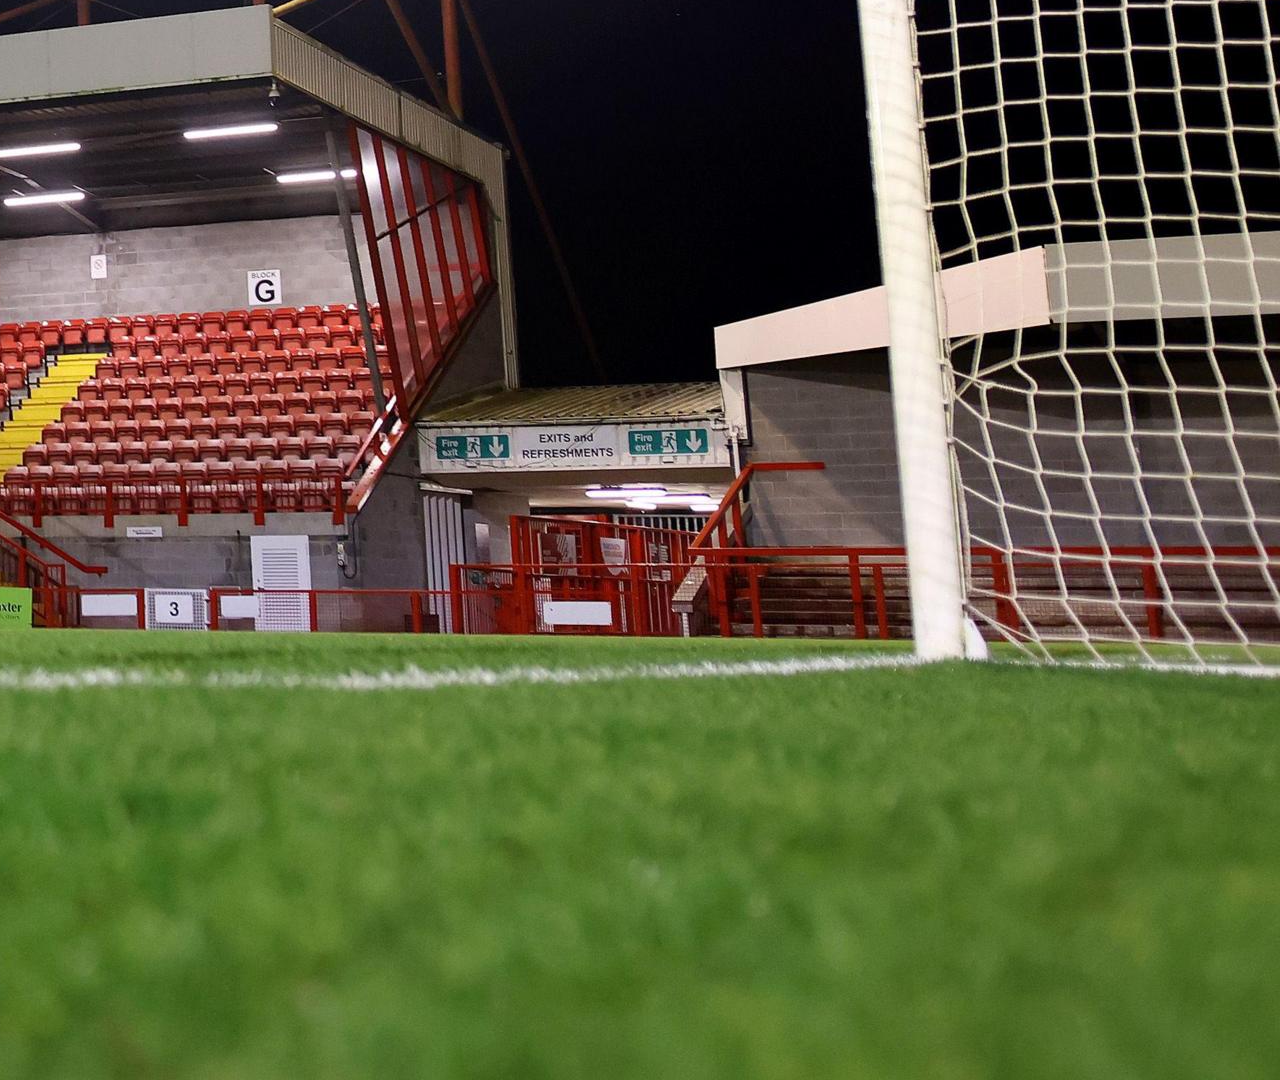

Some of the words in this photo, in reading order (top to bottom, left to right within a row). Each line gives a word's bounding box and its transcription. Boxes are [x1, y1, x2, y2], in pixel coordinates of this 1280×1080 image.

[255, 280, 275, 302] G
[539, 434, 570, 443] EXITS
[574, 433, 594, 442] and
[635, 434, 652, 442] Fire
[522, 448, 613, 459] REFRESHMENTS
[169, 602, 179, 616] 3
